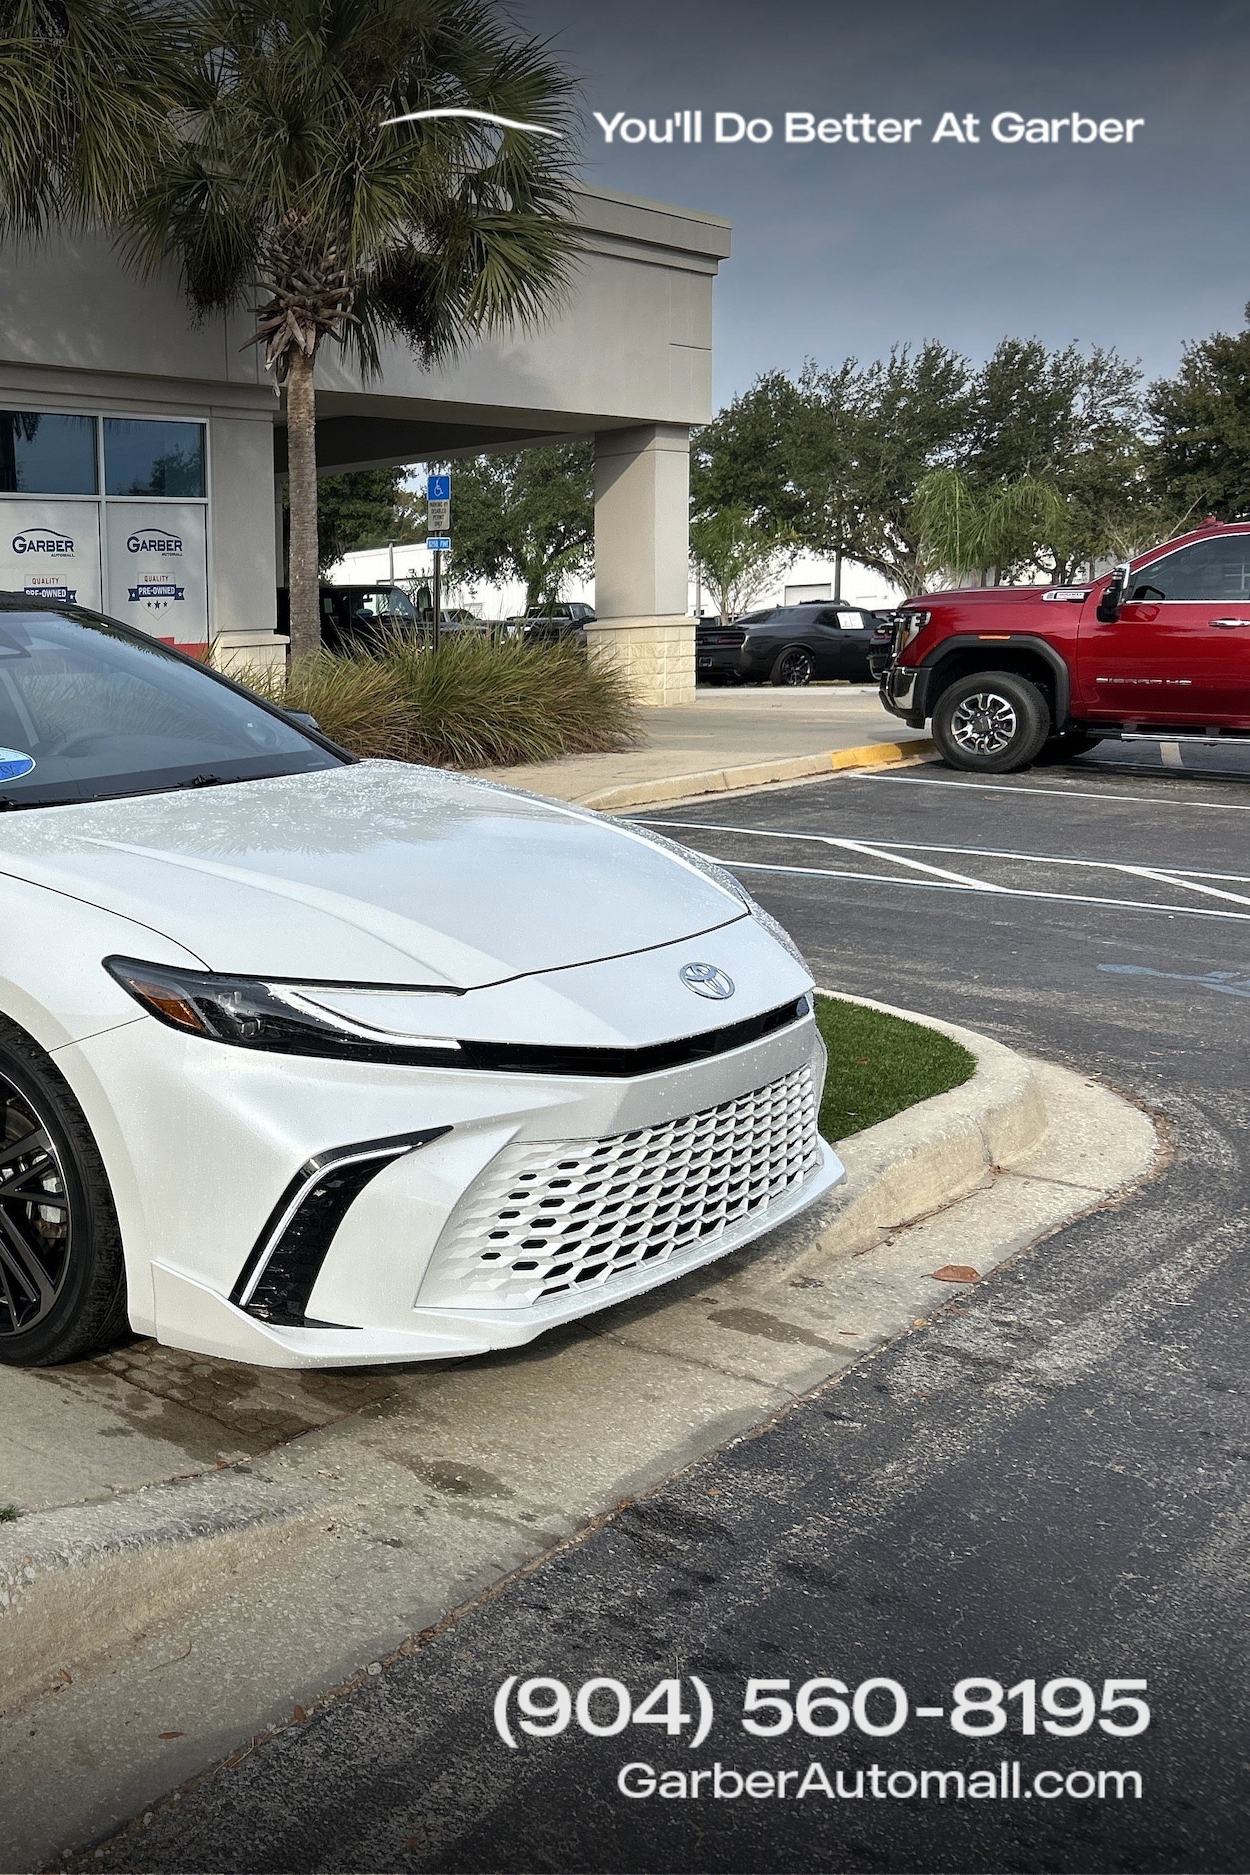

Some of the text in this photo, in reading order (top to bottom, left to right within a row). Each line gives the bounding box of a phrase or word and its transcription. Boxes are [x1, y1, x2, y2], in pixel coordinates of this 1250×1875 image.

[12, 536, 74, 554] GARBER
[127, 536, 182, 553] GARBER
[138, 587, 175, 595] PRE-OWNED
